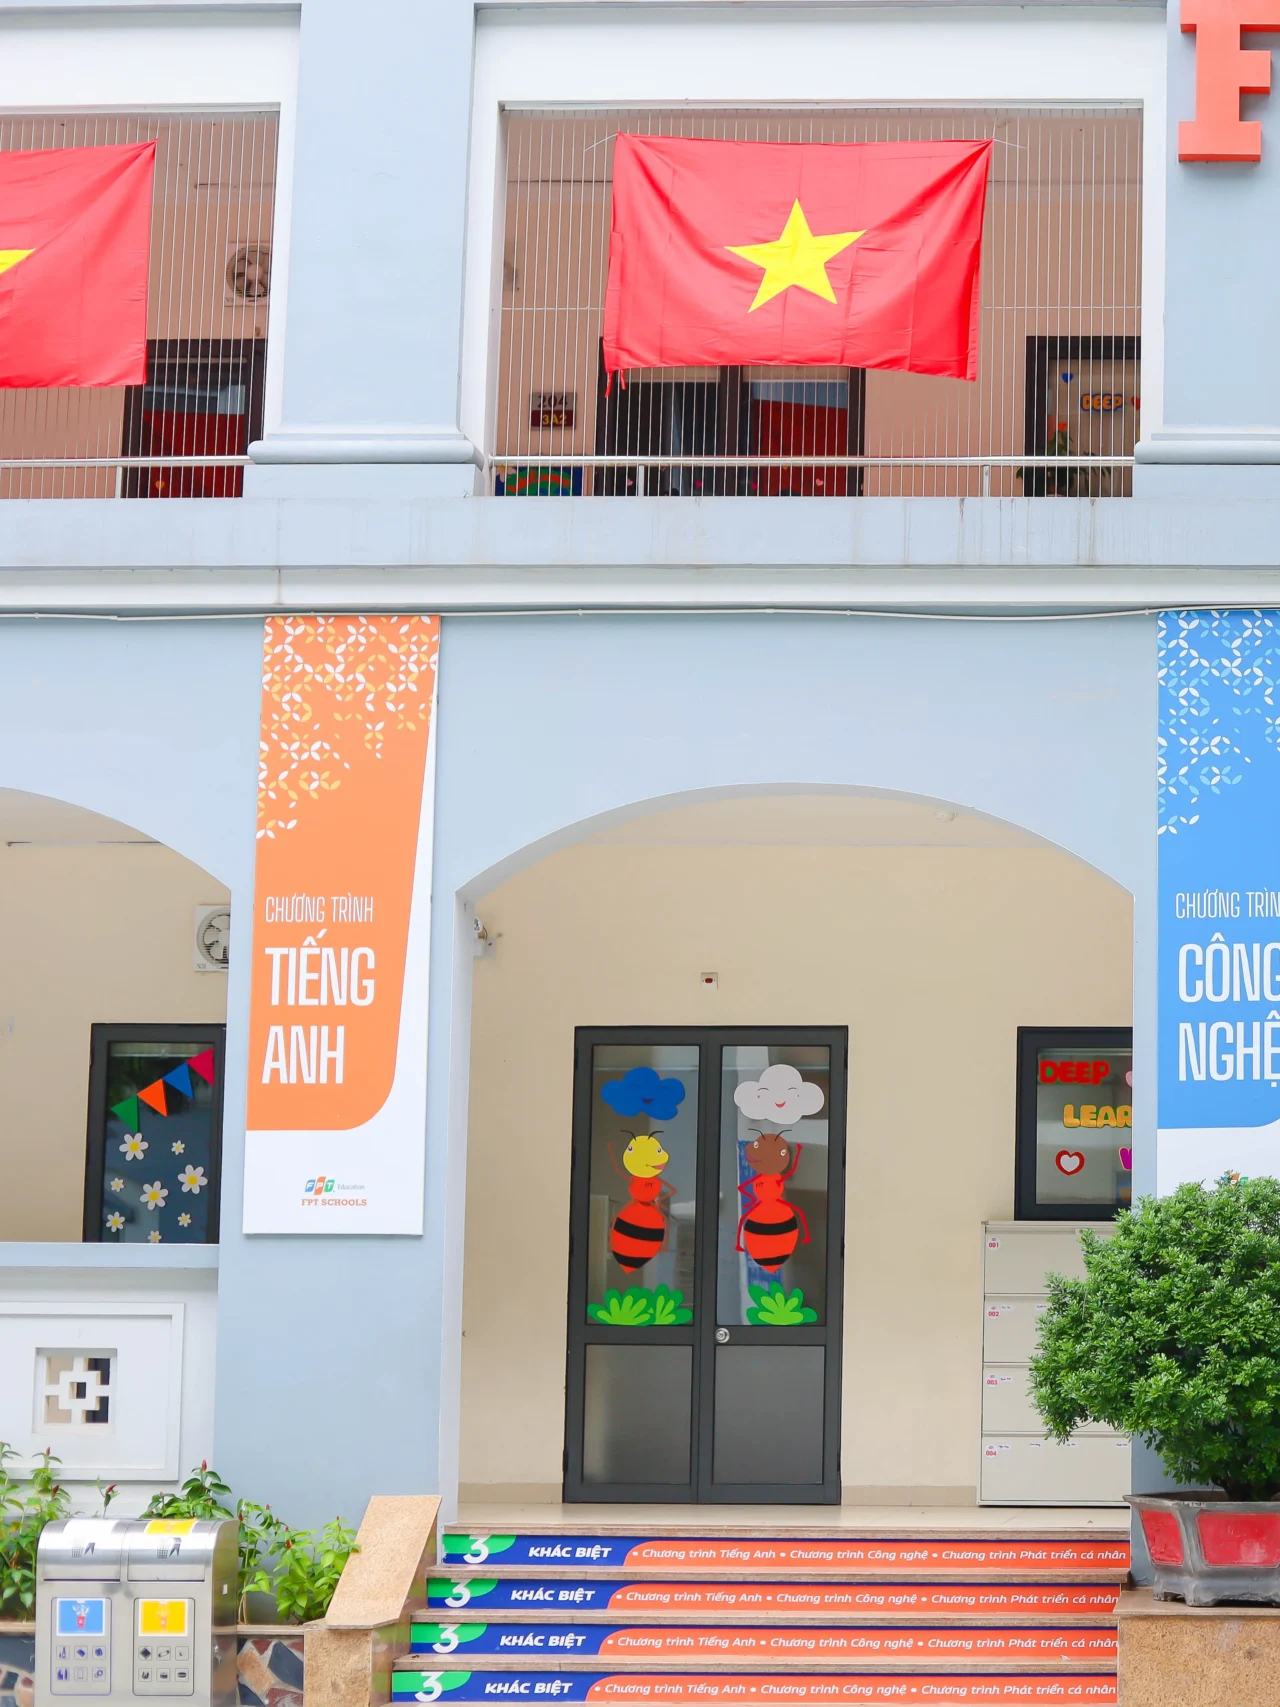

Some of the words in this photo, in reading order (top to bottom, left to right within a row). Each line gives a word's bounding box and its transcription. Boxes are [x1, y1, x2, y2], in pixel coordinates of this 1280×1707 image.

[537, 395, 568, 408] 204
[1081, 393, 1123, 411] DEEP
[542, 414, 567, 425] 3A2
[265, 893, 325, 923] CHƯƠNG
[331, 892, 374, 923] TRÌNH
[1175, 888, 1240, 919] CHƯƠNG
[265, 928, 375, 1006] TIẾNG
[261, 1025, 345, 1084] ANH
[1039, 1060, 1111, 1085] DEEP
[304, 1176, 335, 1195] FPT
[463, 1535, 489, 1564] 3
[529, 1544, 572, 1558] KHÁC
[576, 1544, 612, 1560] BIỆT
[642, 1548, 687, 1560] Chương
[690, 1548, 716, 1558] trình
[720, 1548, 750, 1560] Tiếng
[753, 1550, 776, 1558] Anh
[790, 1550, 834, 1560] Chương
[837, 1550, 864, 1558] trình
[868, 1550, 896, 1560] Công
[900, 1550, 928, 1562] nghệ
[942, 1550, 986, 1562] Chương
[989, 1550, 1016, 1560] trình
[1020, 1550, 1046, 1560] Phát
[1051, 1548, 1076, 1560] triển
[1081, 1550, 1094, 1560] cá
[1098, 1550, 1126, 1560] nhân
[444, 1578, 471, 1607] 3
[511, 1588, 556, 1600] KHÁC
[558, 1588, 595, 1604] BIỆT
[626, 1592, 672, 1604] Chương
[674, 1592, 702, 1602] trình
[705, 1592, 736, 1604] Tiếng
[739, 1594, 762, 1602] Anh
[776, 1594, 821, 1604] Chương
[824, 1594, 852, 1602] trình
[855, 1594, 884, 1604] Công
[888, 1594, 917, 1606] nghệ
[931, 1594, 976, 1606] Chương
[979, 1594, 1007, 1604] trình
[1010, 1594, 1038, 1604] Phát
[1042, 1594, 1068, 1604] triển
[1072, 1594, 1086, 1604] cá
[1090, 1594, 1118, 1604] nhân
[414, 1672, 443, 1702] 3
[485, 1680, 532, 1694] KHÁC
[534, 1680, 572, 1696] BIỆT
[605, 1684, 652, 1696] Chương
[654, 1684, 683, 1694] trình
[687, 1682, 718, 1696] Tiếng
[722, 1684, 746, 1694] Anh
[761, 1684, 807, 1696] Chương
[810, 1684, 839, 1694] trình
[842, 1684, 873, 1696] Công
[876, 1684, 906, 1696] nghệ
[921, 1686, 968, 1696] Chương
[971, 1686, 1000, 1694] trình
[1004, 1686, 1033, 1694] Phát
[1036, 1684, 1064, 1694] triển
[1068, 1686, 1082, 1694] cá
[1086, 1684, 1116, 1694] nhân
